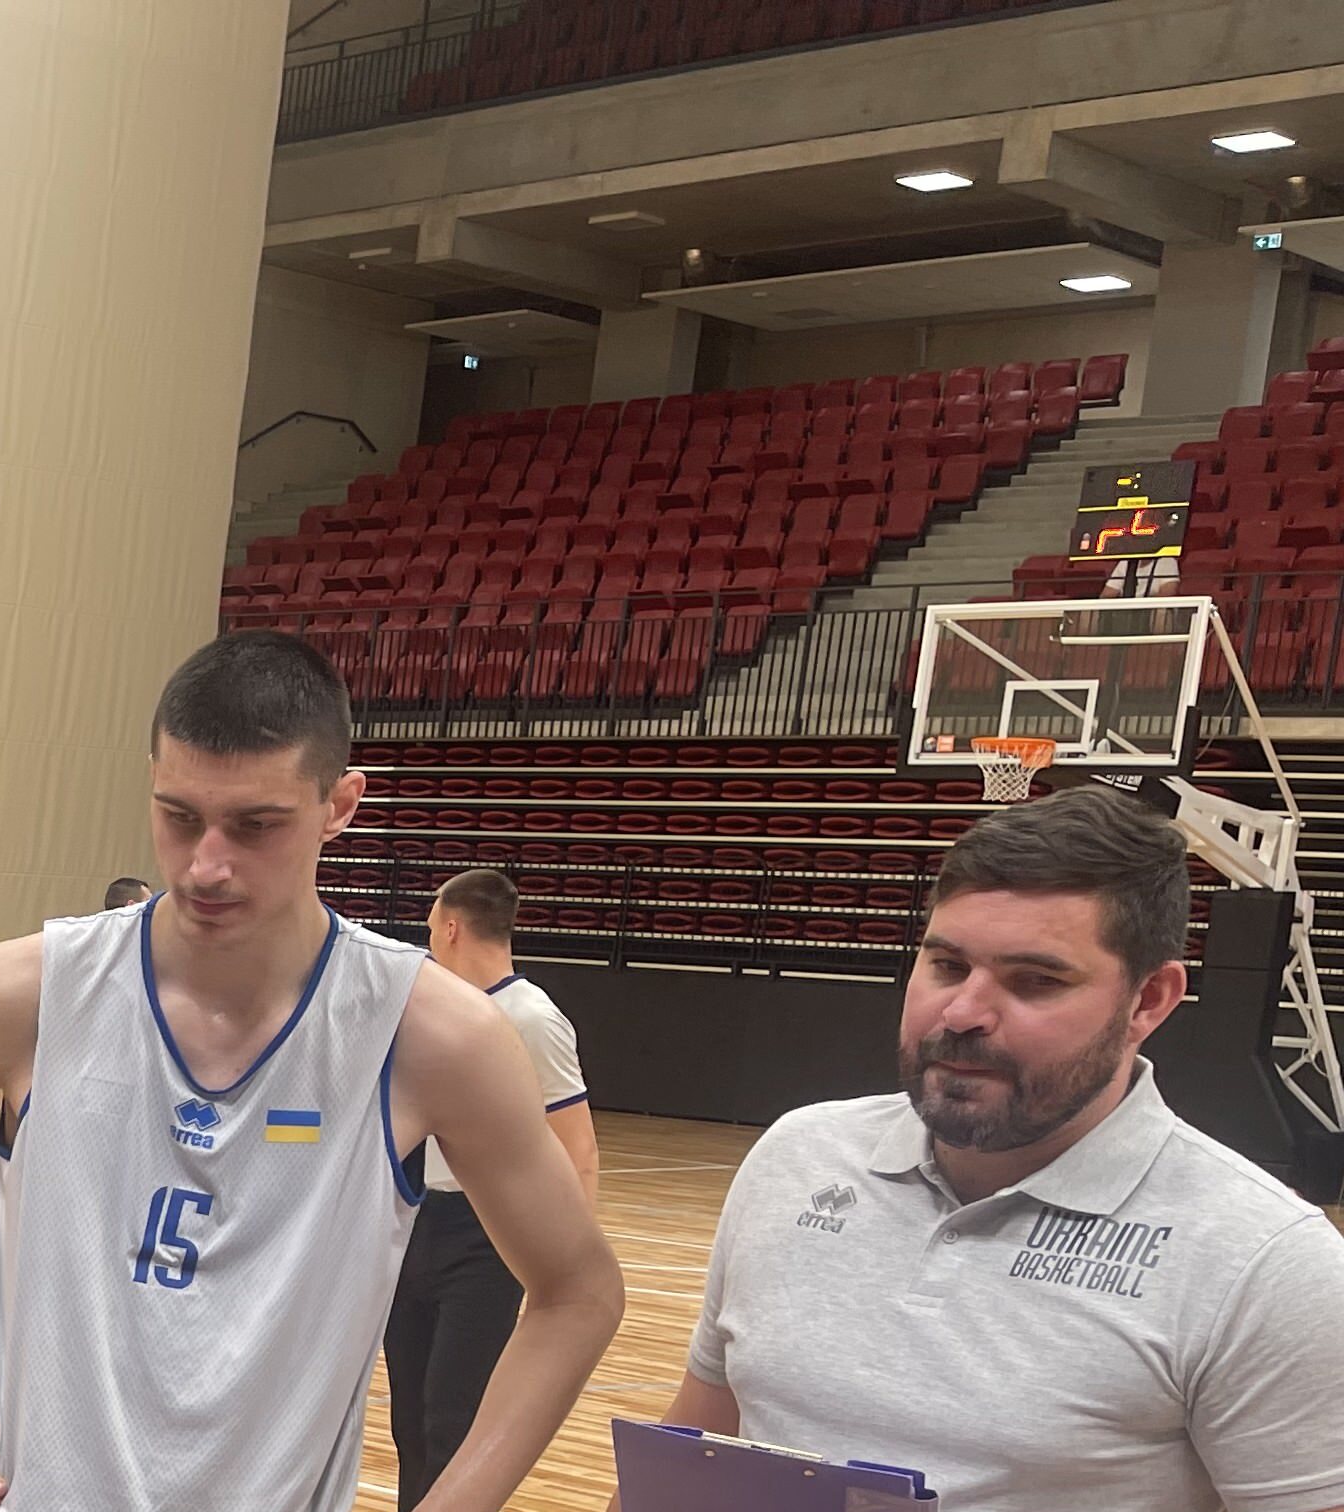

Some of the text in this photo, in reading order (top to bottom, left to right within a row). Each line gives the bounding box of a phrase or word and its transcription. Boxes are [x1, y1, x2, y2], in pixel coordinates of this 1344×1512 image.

[133, 1186, 214, 1289] 15
[797, 1210, 846, 1233] errea
[1027, 1206, 1173, 1269] UKRAINE
[1009, 1250, 1144, 1298] BASKETBALL
